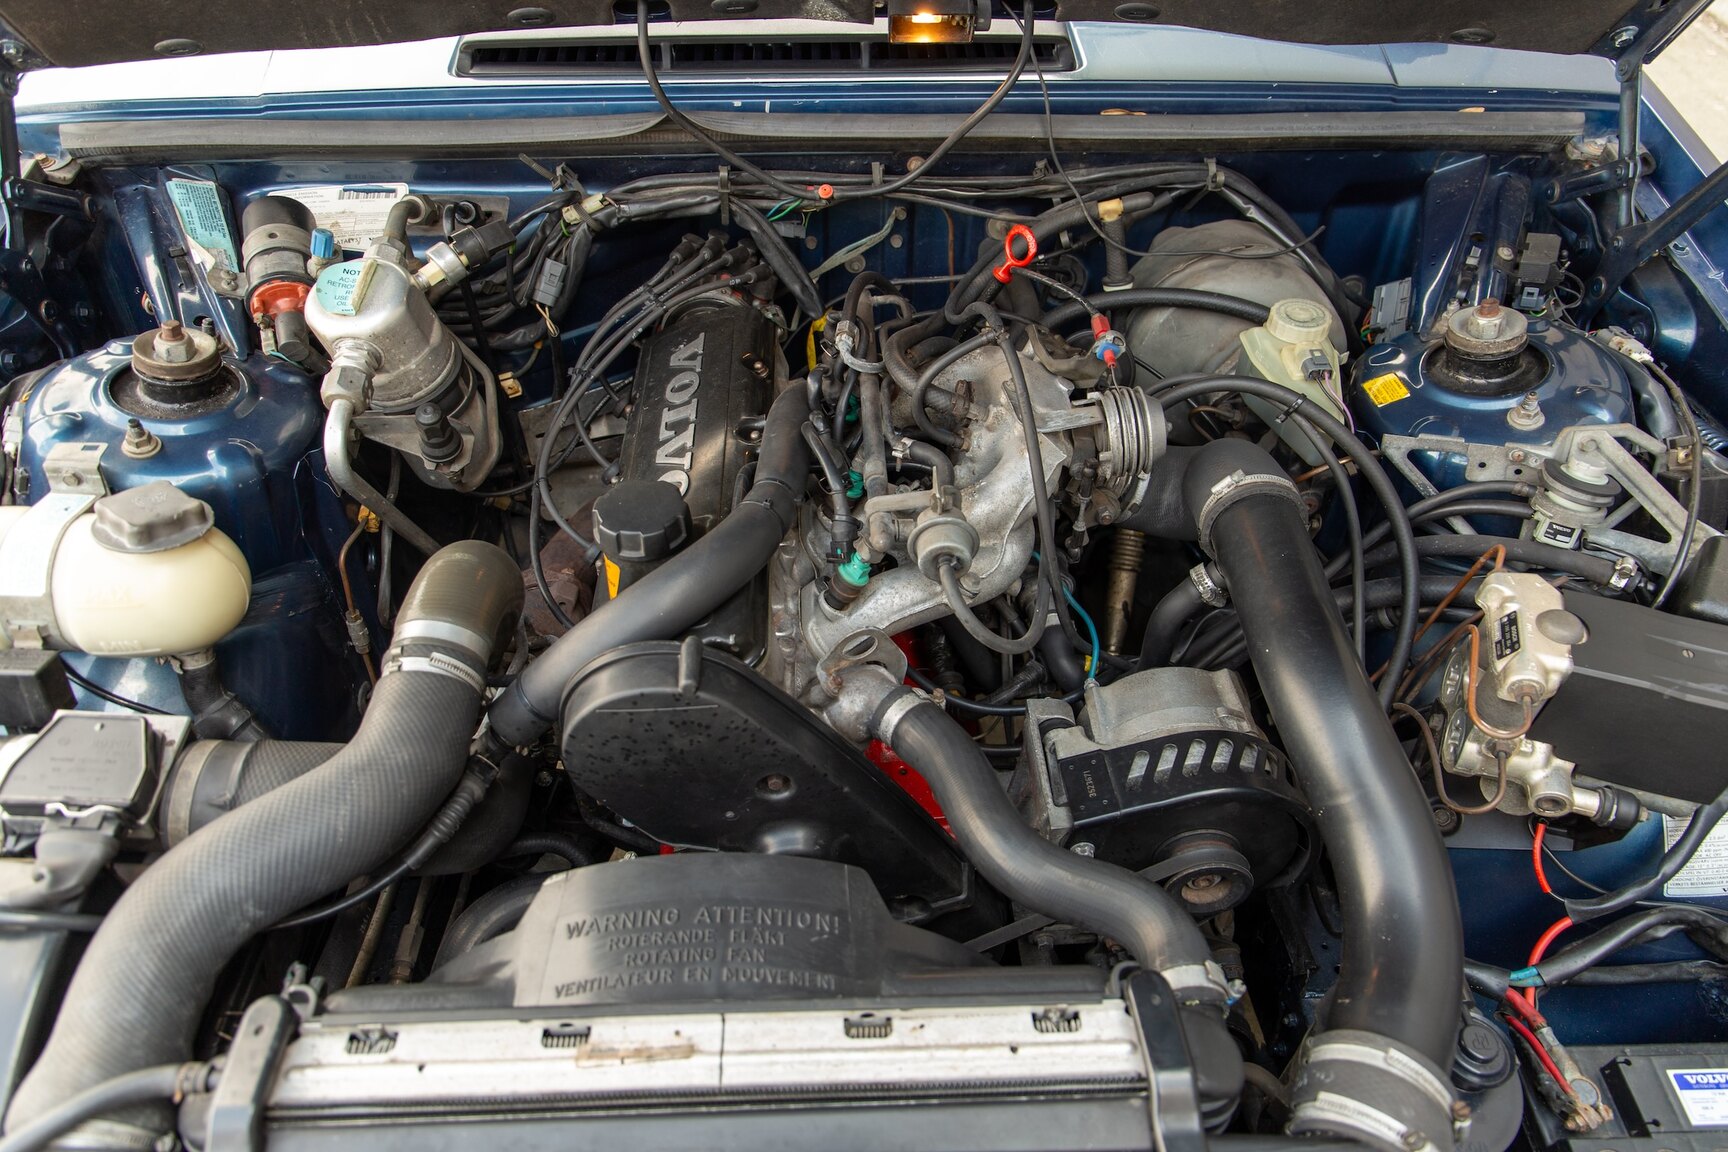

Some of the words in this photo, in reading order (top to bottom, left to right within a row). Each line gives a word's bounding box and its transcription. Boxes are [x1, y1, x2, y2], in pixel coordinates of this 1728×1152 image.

[567, 908, 680, 939] WARNING
[694, 906, 839, 934] ATTENTION!
[609, 929, 715, 951] ROTERANDE
[729, 927, 787, 946] FLÄKT
[624, 947, 716, 967] ROTATING
[728, 947, 765, 962] FAN
[554, 969, 673, 999] VENTILATEUR
[684, 967, 712, 982] EN
[722, 967, 836, 990] MOUVEMENT
[1683, 1074, 1728, 1084] VOLV
